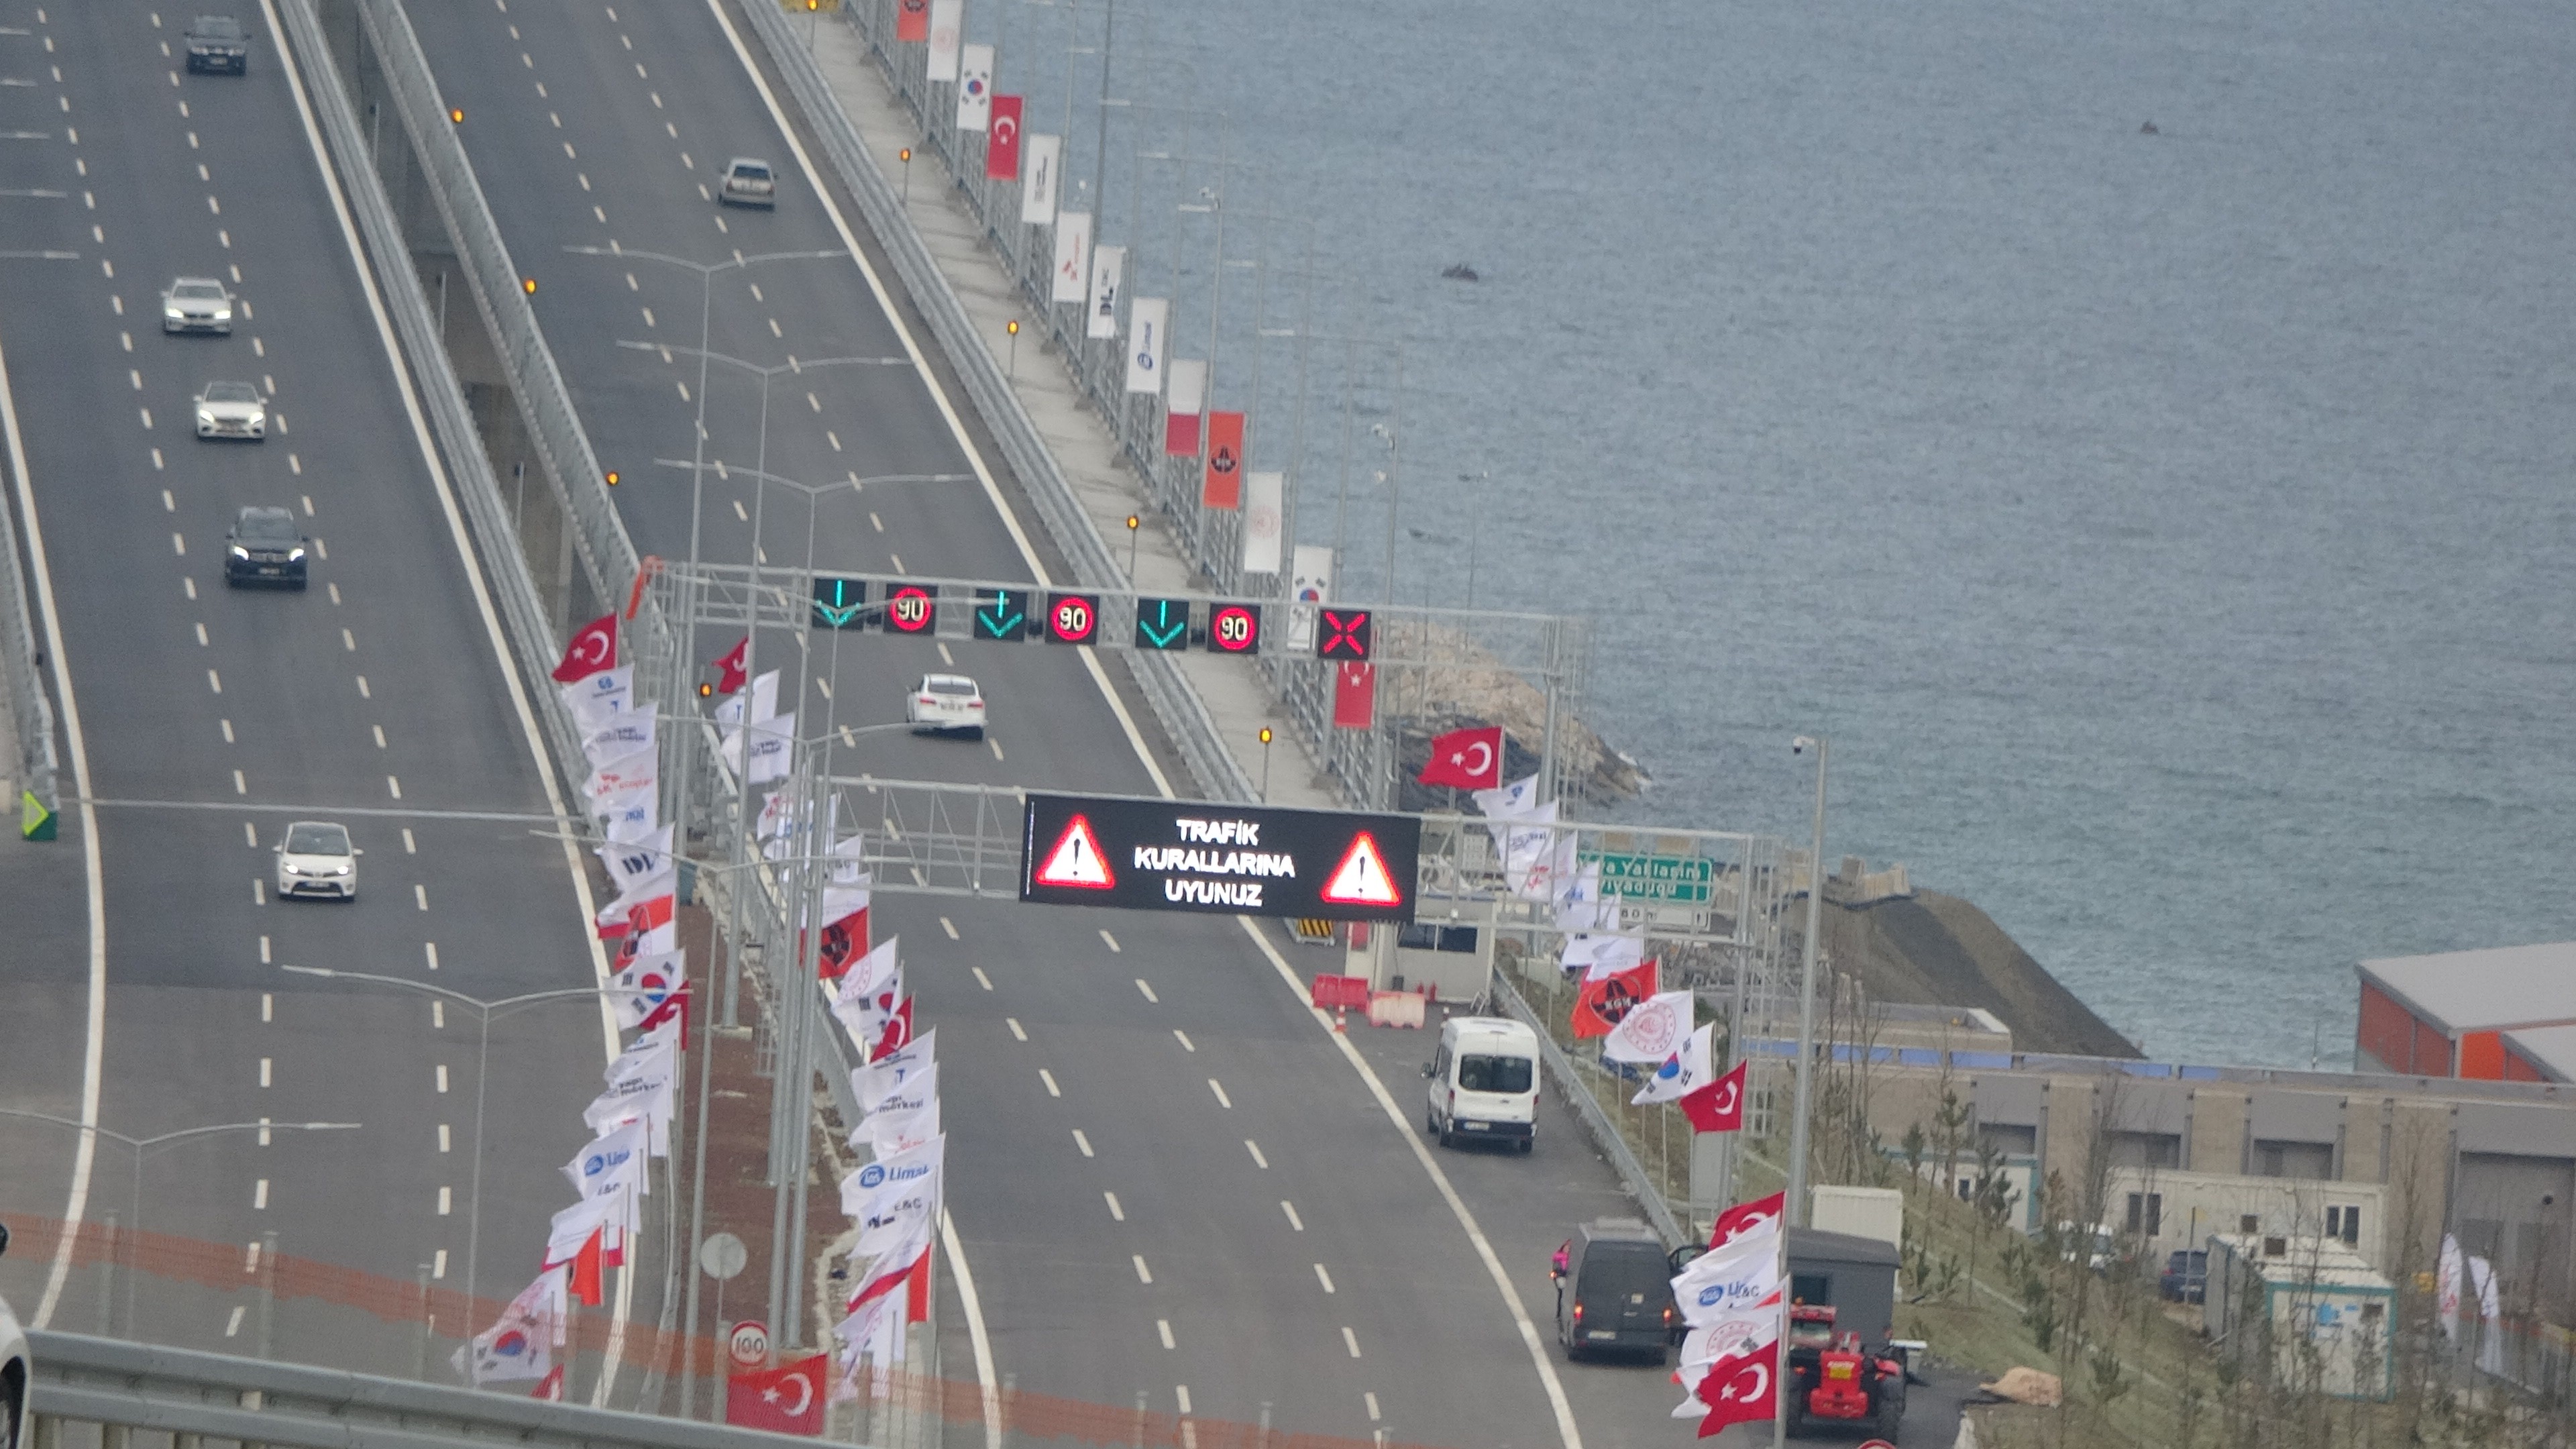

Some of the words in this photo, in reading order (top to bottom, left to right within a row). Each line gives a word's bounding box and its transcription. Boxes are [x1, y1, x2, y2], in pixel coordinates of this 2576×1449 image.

[898, 598, 924, 622] 90
[1060, 607, 1086, 631] 90
[1222, 617, 1248, 641] 90
[1176, 820, 1260, 846] TRAFİK
[1134, 847, 1295, 878] KURALLARINA
[1165, 879, 1263, 906] UYUNUZ
[736, 1337, 764, 1354] 100
